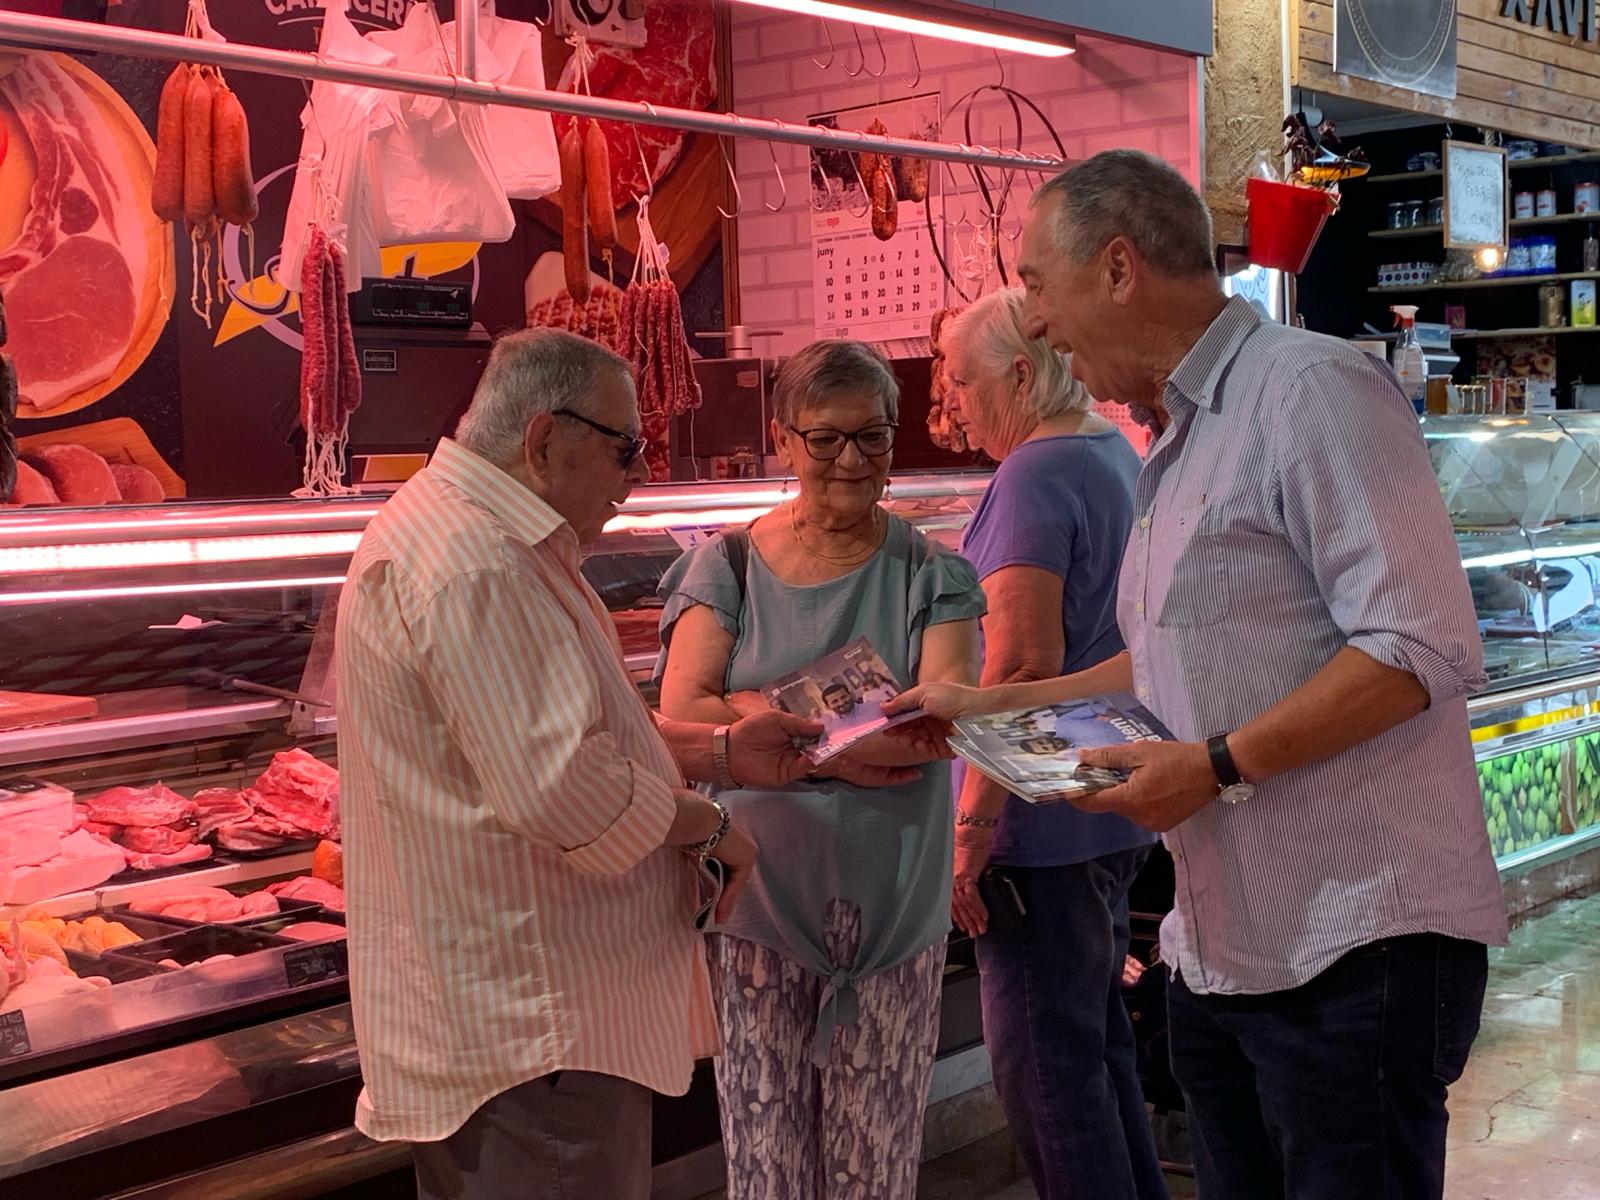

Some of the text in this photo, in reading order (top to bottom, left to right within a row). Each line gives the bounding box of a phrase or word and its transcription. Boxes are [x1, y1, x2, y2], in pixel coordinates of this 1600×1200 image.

[915, 231, 919, 241] 1
[816, 246, 835, 259] juny
[828, 260, 833, 270] 3
[846, 257, 851, 267] 4
[863, 255, 867, 265] 5
[880, 253, 885, 263] 6
[898, 250, 902, 261] 7
[825, 277, 834, 287] 10
[845, 275, 851, 284] 11
[861, 272, 868, 282] 12
[879, 270, 885, 280] 13
[895, 268, 903, 278] 14
[913, 266, 920, 276] 15
[827, 294, 834, 303] 17
[844, 292, 852, 301] 18
[861, 290, 869, 300] 19
[877, 288, 886, 298] 20
[896, 286, 903, 296] 21
[913, 284, 920, 294] 22
[845, 309, 853, 319] 25
[861, 307, 869, 317] 26
[879, 305, 887, 315] 27
[895, 303, 904, 313] 28
[912, 301, 920, 311] 29
